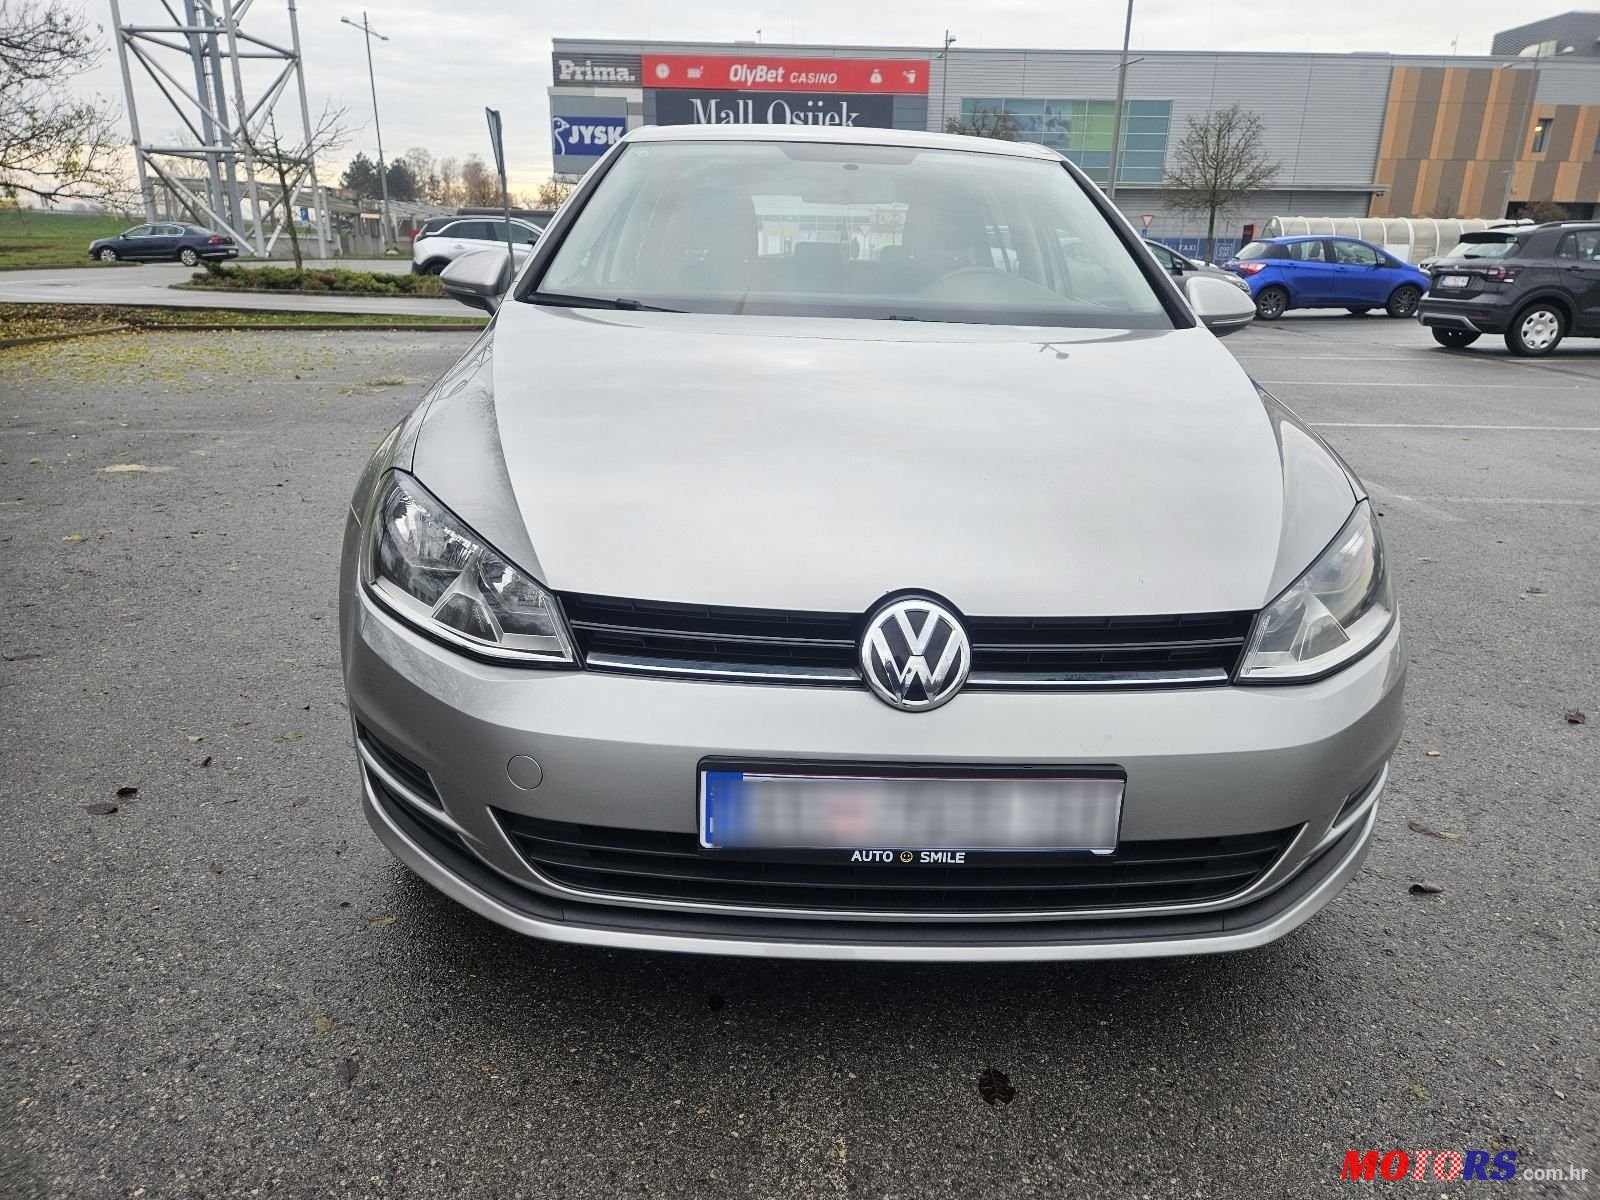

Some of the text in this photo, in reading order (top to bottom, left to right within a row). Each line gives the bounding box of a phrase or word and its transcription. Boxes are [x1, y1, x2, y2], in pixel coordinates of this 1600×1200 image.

[558, 59, 636, 82] Prima.
[729, 64, 838, 86] OlyBet CASINO
[689, 98, 753, 124] Mall
[568, 125, 624, 145] JYSK
[851, 850, 965, 864] AUTO SMILE
